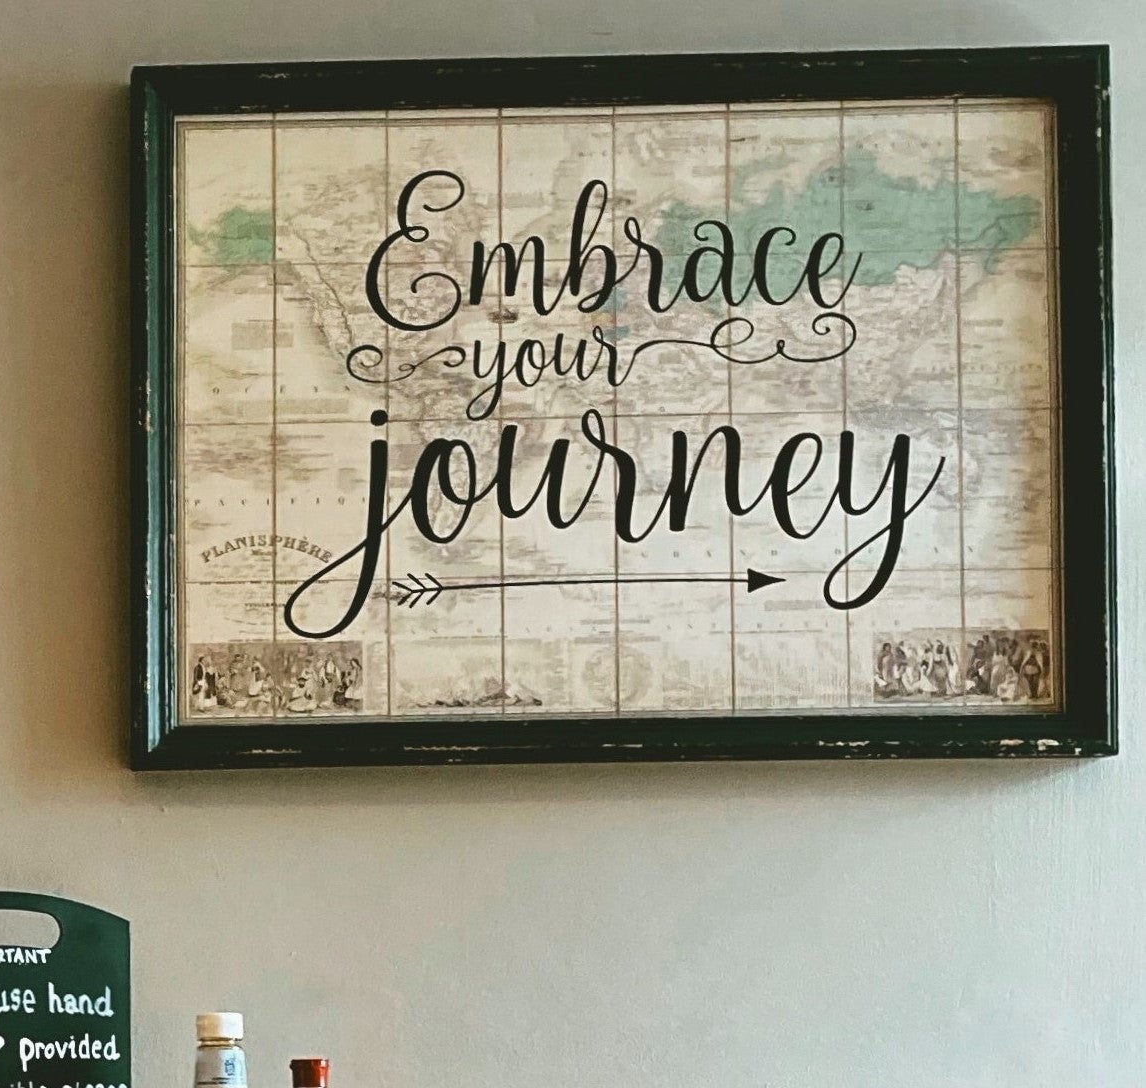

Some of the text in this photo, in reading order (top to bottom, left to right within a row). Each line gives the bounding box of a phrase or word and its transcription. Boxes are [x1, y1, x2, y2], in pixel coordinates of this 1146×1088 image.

[365, 169, 862, 332] Embrace
[464, 325, 632, 420] your
[284, 408, 946, 639] journey
[48, 982, 114, 1018] hand
[19, 1033, 121, 1072] provided
